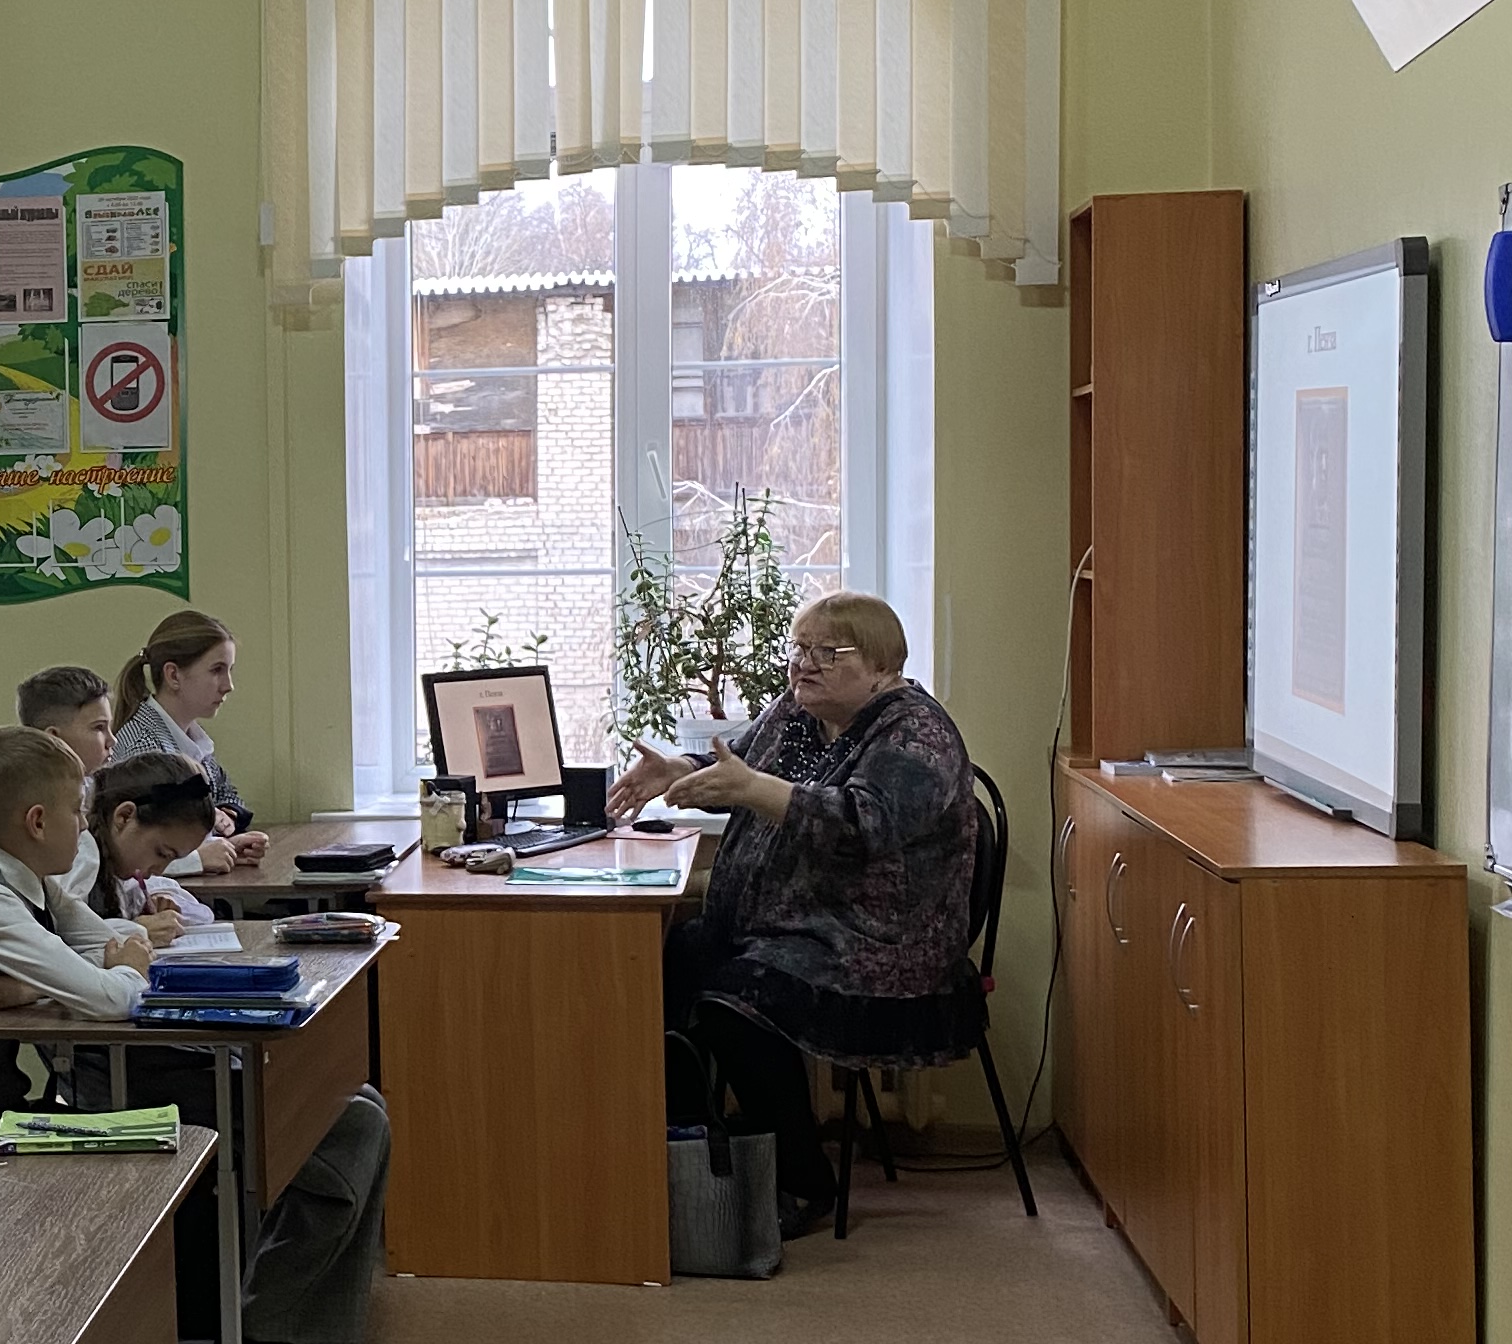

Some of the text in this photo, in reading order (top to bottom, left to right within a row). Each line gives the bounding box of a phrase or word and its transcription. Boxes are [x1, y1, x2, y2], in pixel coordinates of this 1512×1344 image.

[83, 262, 134, 276] СДАЙ
[126, 280, 158, 290] спаси
[49, 464, 176, 494] настроение
